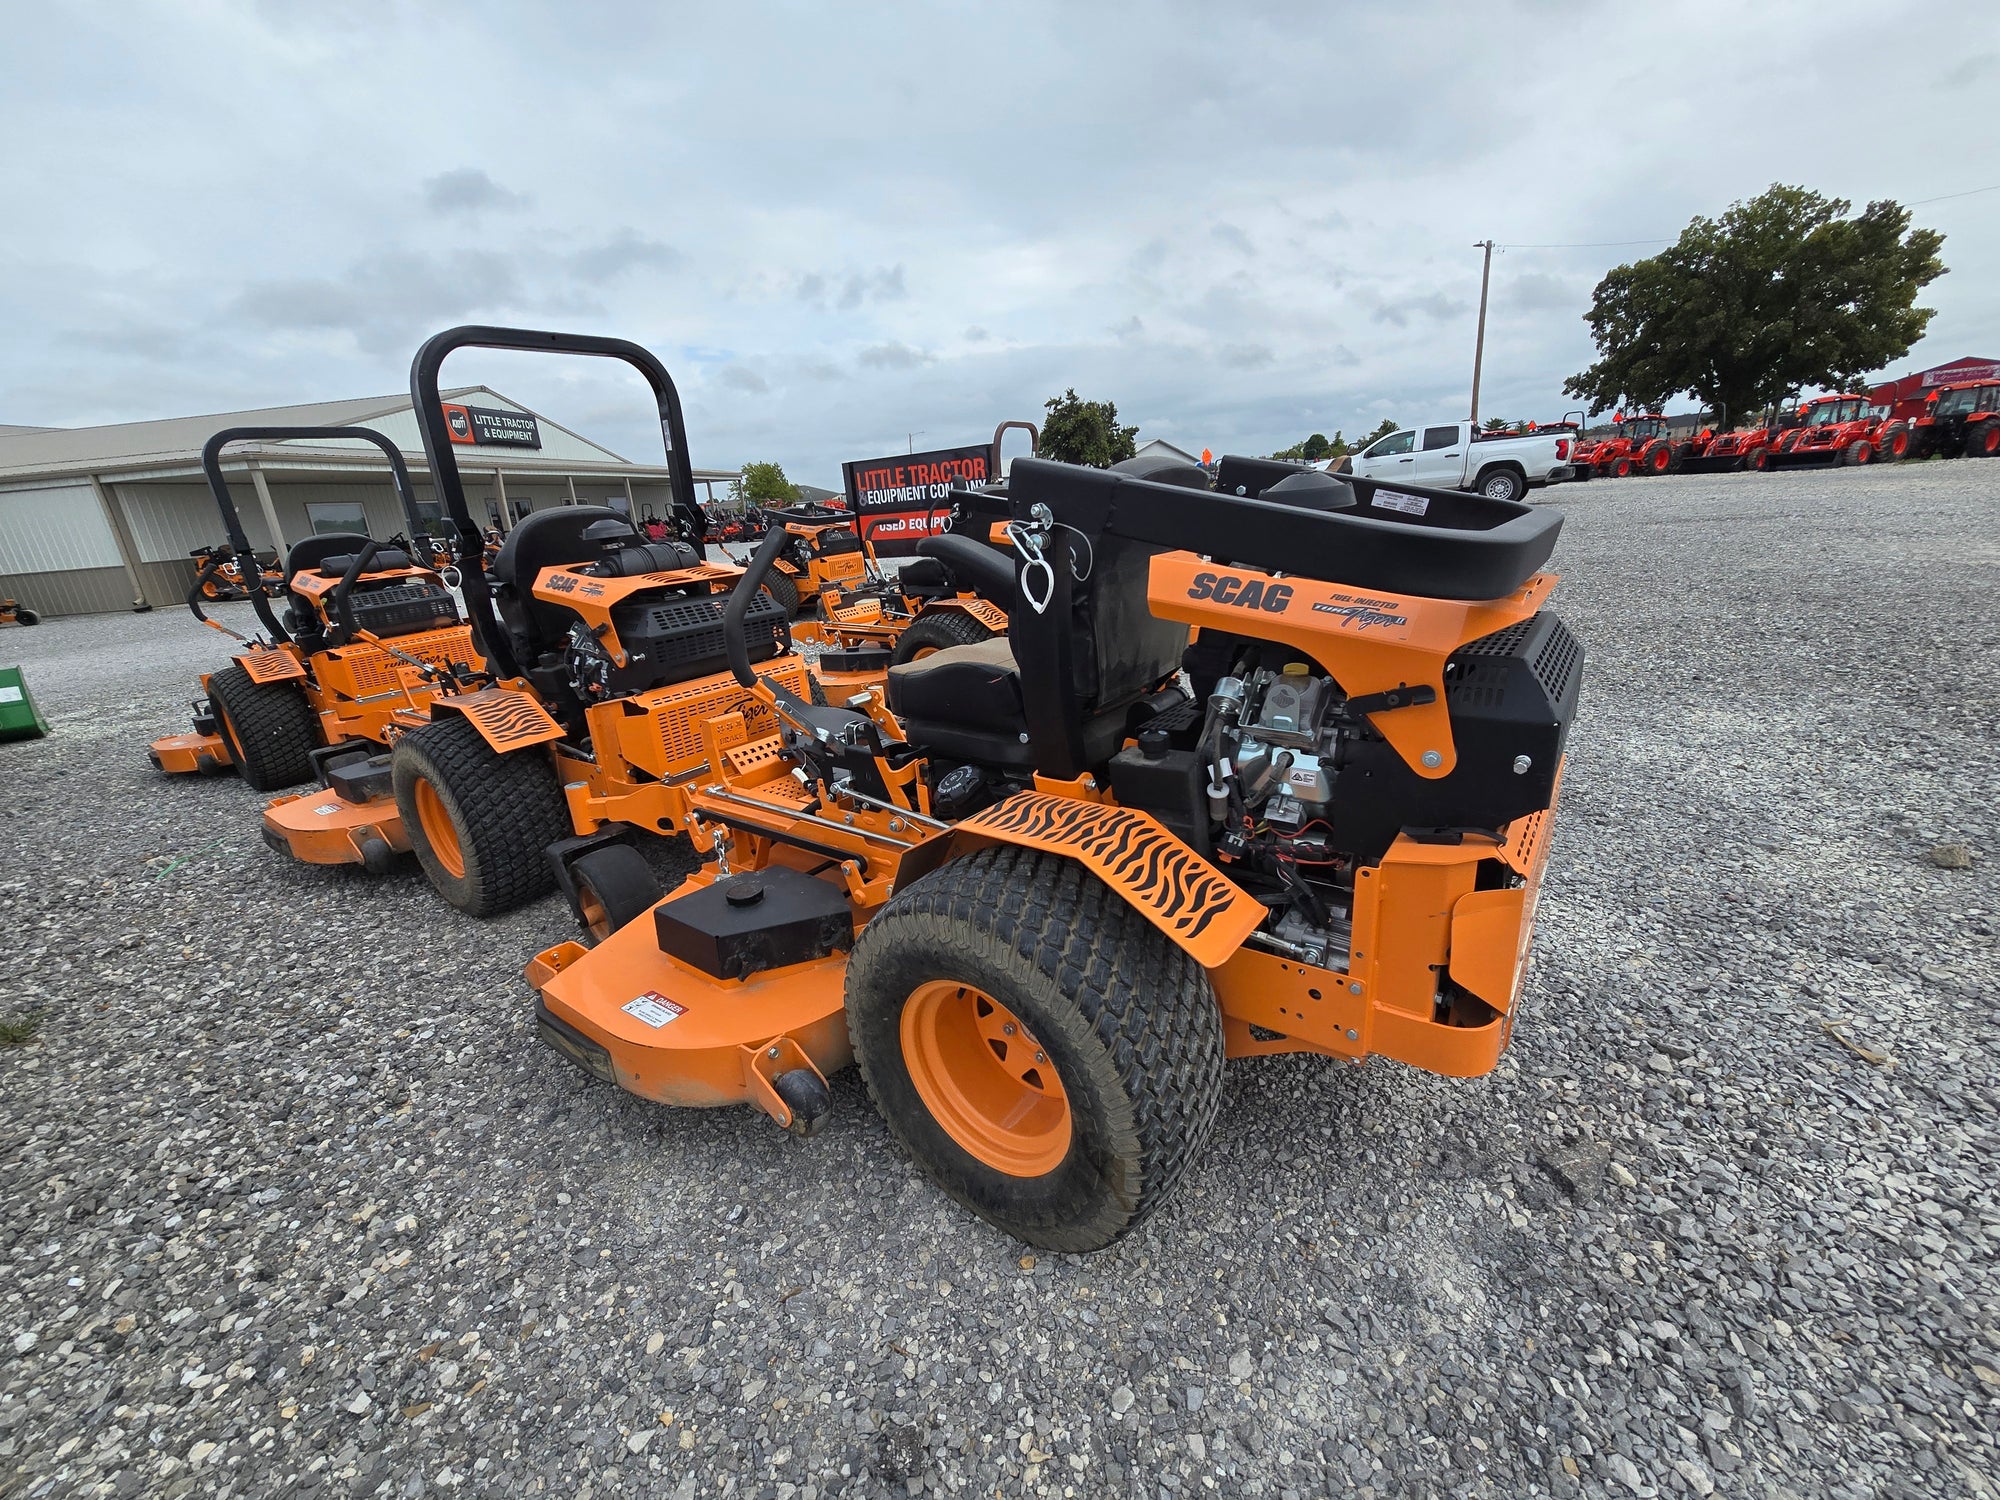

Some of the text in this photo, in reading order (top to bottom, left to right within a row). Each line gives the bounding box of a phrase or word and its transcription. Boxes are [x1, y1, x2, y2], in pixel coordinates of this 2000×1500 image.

[474, 414, 536, 430] LITTLE TRACTOR
[484, 428, 533, 441] & EQUIPMENT
[856, 457, 986, 492] LITTLE TRACTOR
[879, 518, 906, 532] USED
[545, 574, 579, 593] SCAG
[1187, 572, 1295, 614] SCAG
[1330, 593, 1400, 610] FUEL-INJECTED
[1341, 606, 1395, 631] Tiger
[655, 997, 683, 1014] DANGER
